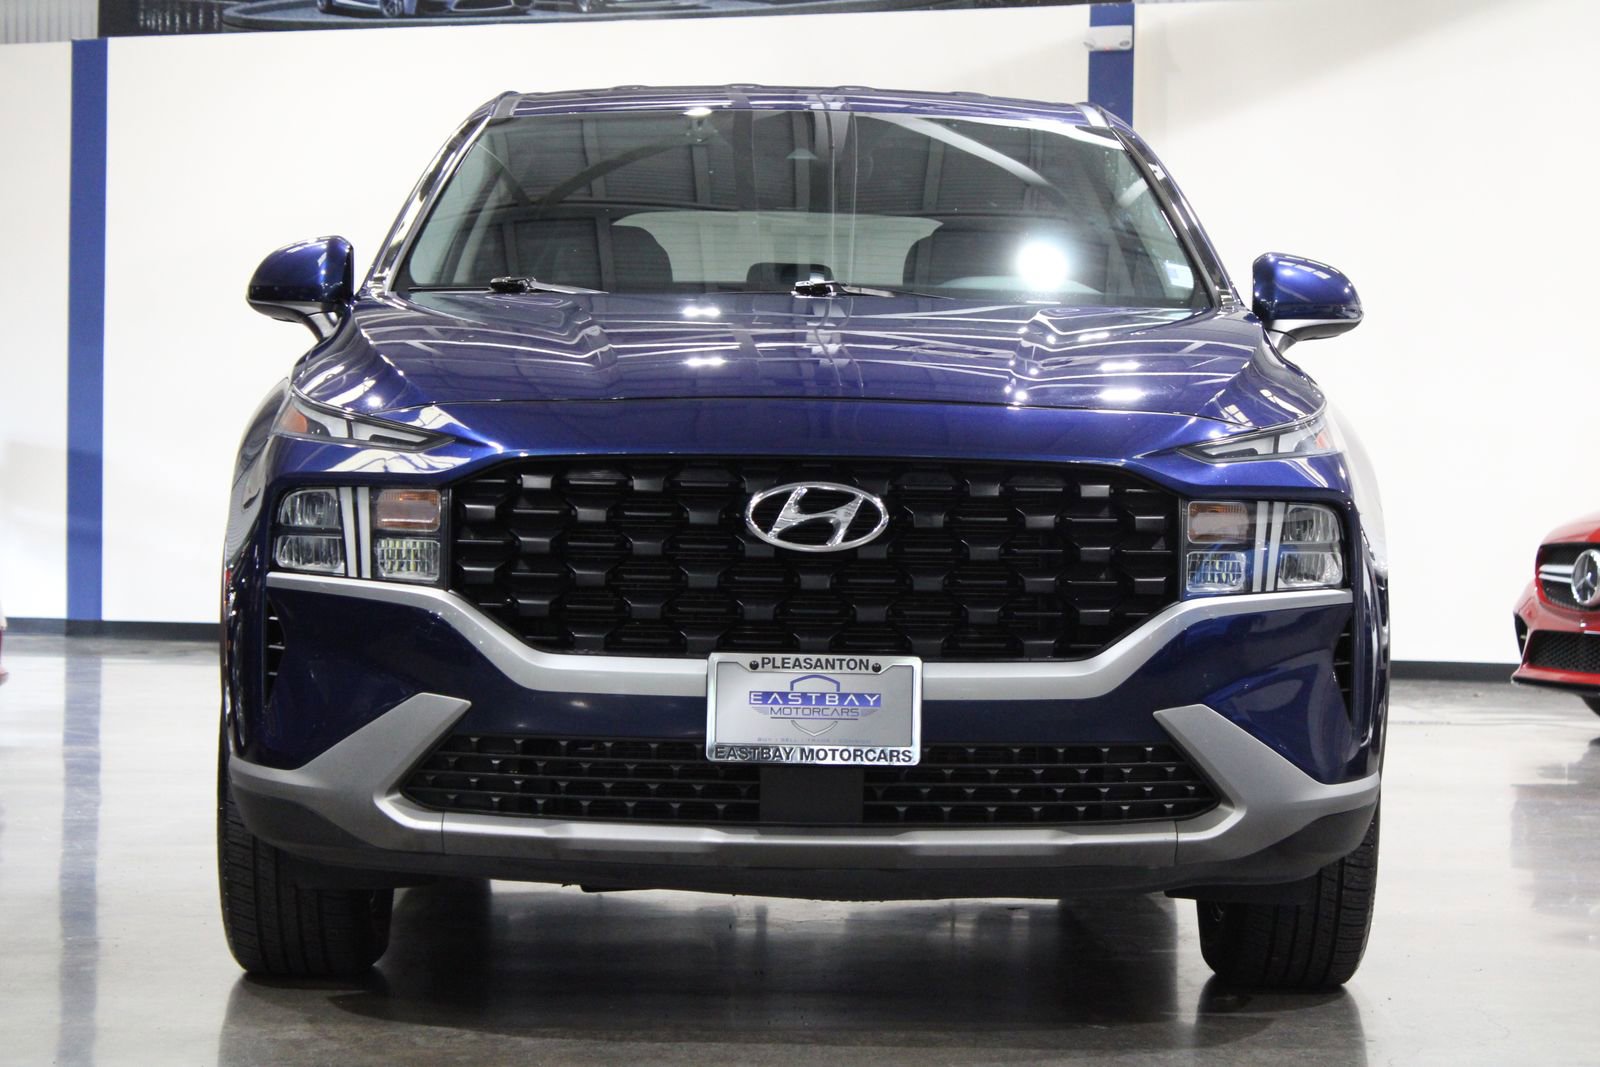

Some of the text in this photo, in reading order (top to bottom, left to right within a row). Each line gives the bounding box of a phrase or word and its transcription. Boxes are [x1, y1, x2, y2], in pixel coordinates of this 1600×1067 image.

[761, 656, 870, 671] PLEASANTON
[750, 692, 880, 706] EASTBAY
[769, 706, 860, 717] MOTORCARS
[714, 747, 913, 763] EASTBAY MOTORCARS
